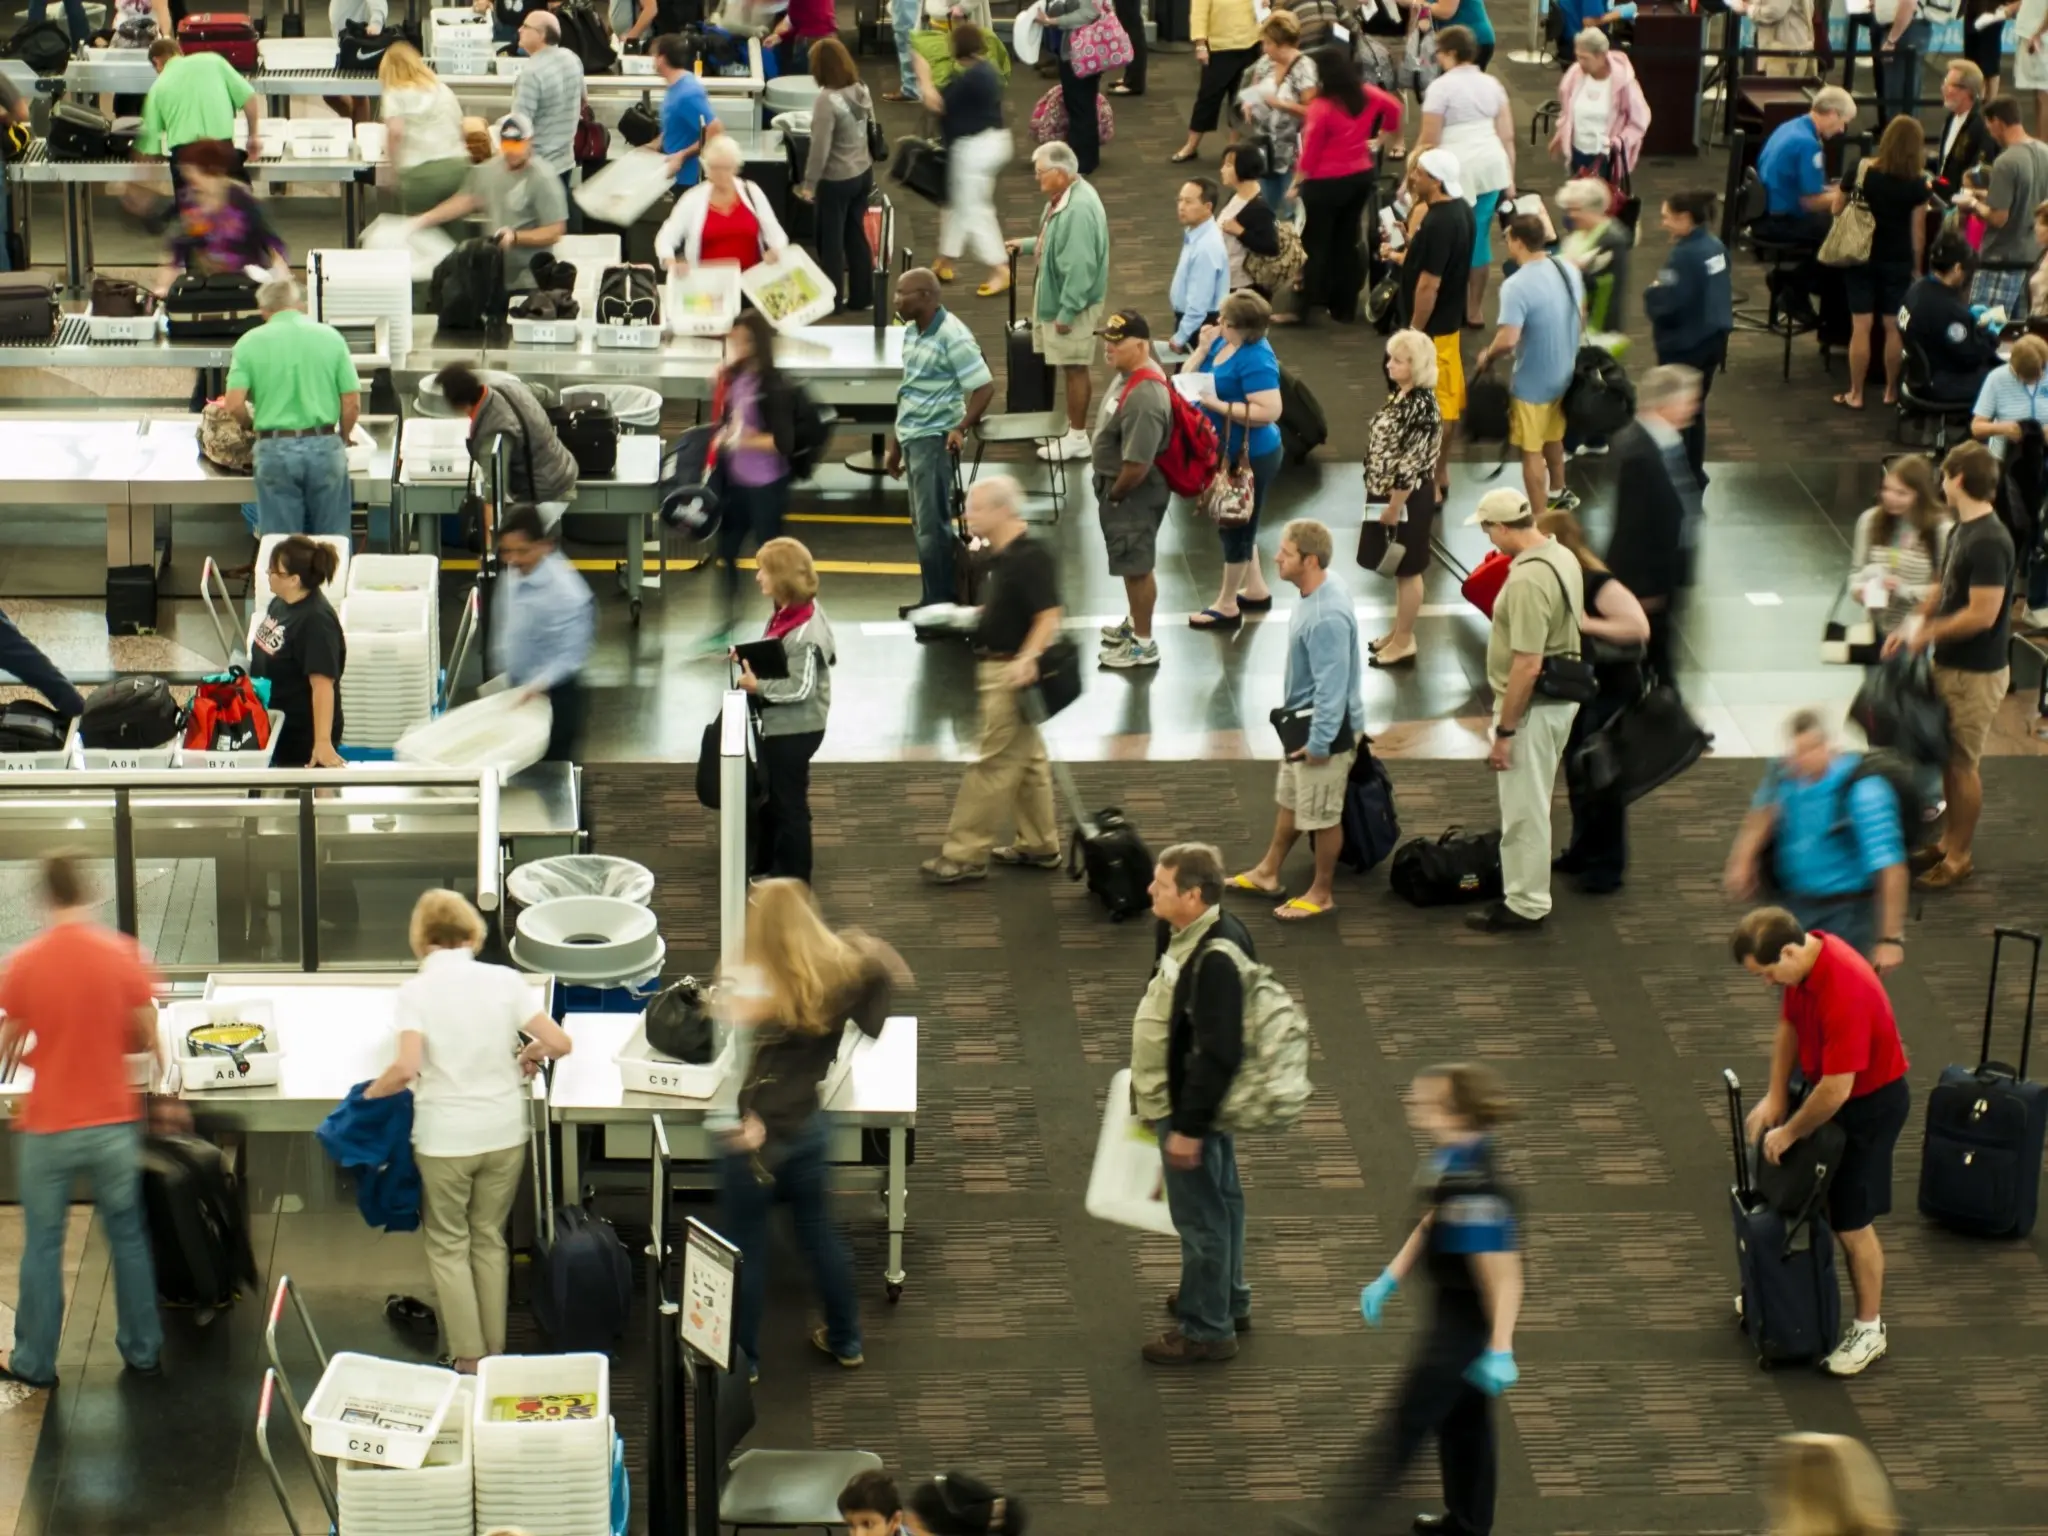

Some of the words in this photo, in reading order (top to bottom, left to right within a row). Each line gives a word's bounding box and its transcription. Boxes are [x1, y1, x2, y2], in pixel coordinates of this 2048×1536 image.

[430, 465, 453, 473] A56
[110, 760, 137, 768] A08
[209, 760, 235, 768] B76
[649, 1075, 679, 1087] C97
[348, 1439, 385, 1455] C20
